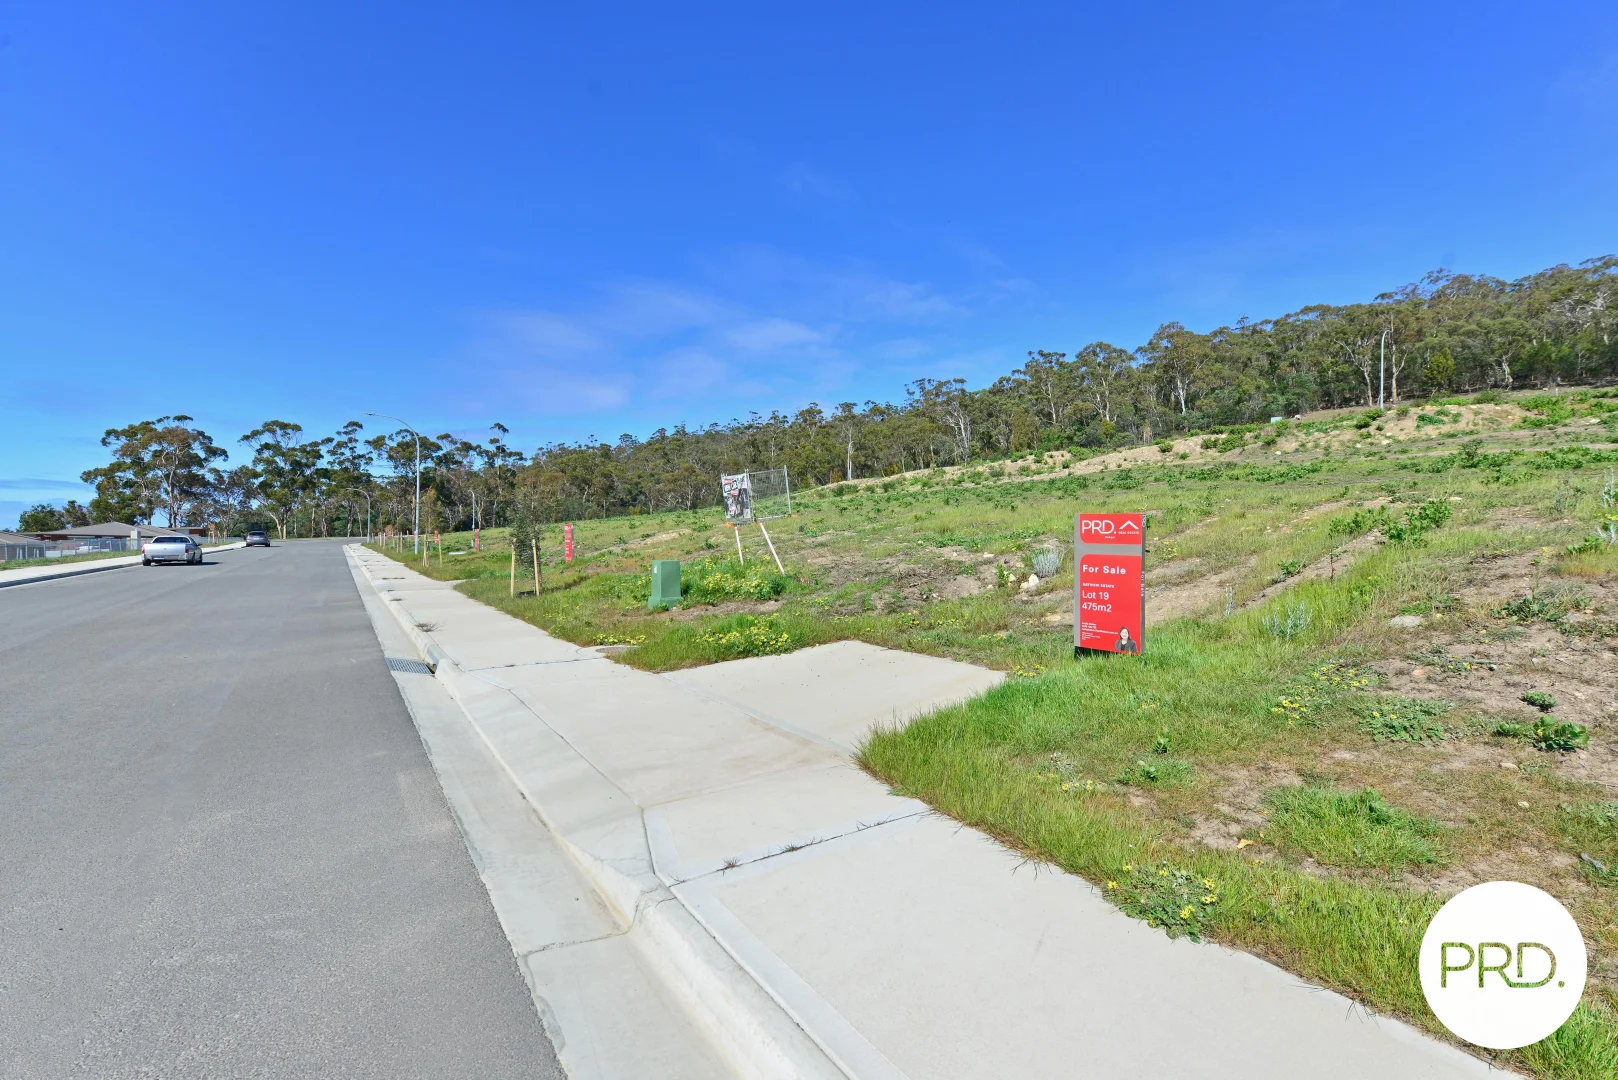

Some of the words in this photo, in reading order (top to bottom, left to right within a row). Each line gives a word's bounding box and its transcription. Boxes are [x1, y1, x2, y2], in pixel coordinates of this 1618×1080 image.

[1082, 564, 1098, 572] For
[1103, 566, 1126, 574] Sale
[1082, 590, 1096, 599] Lot
[1099, 592, 1109, 600] 19
[1082, 602, 1112, 612] 475m2
